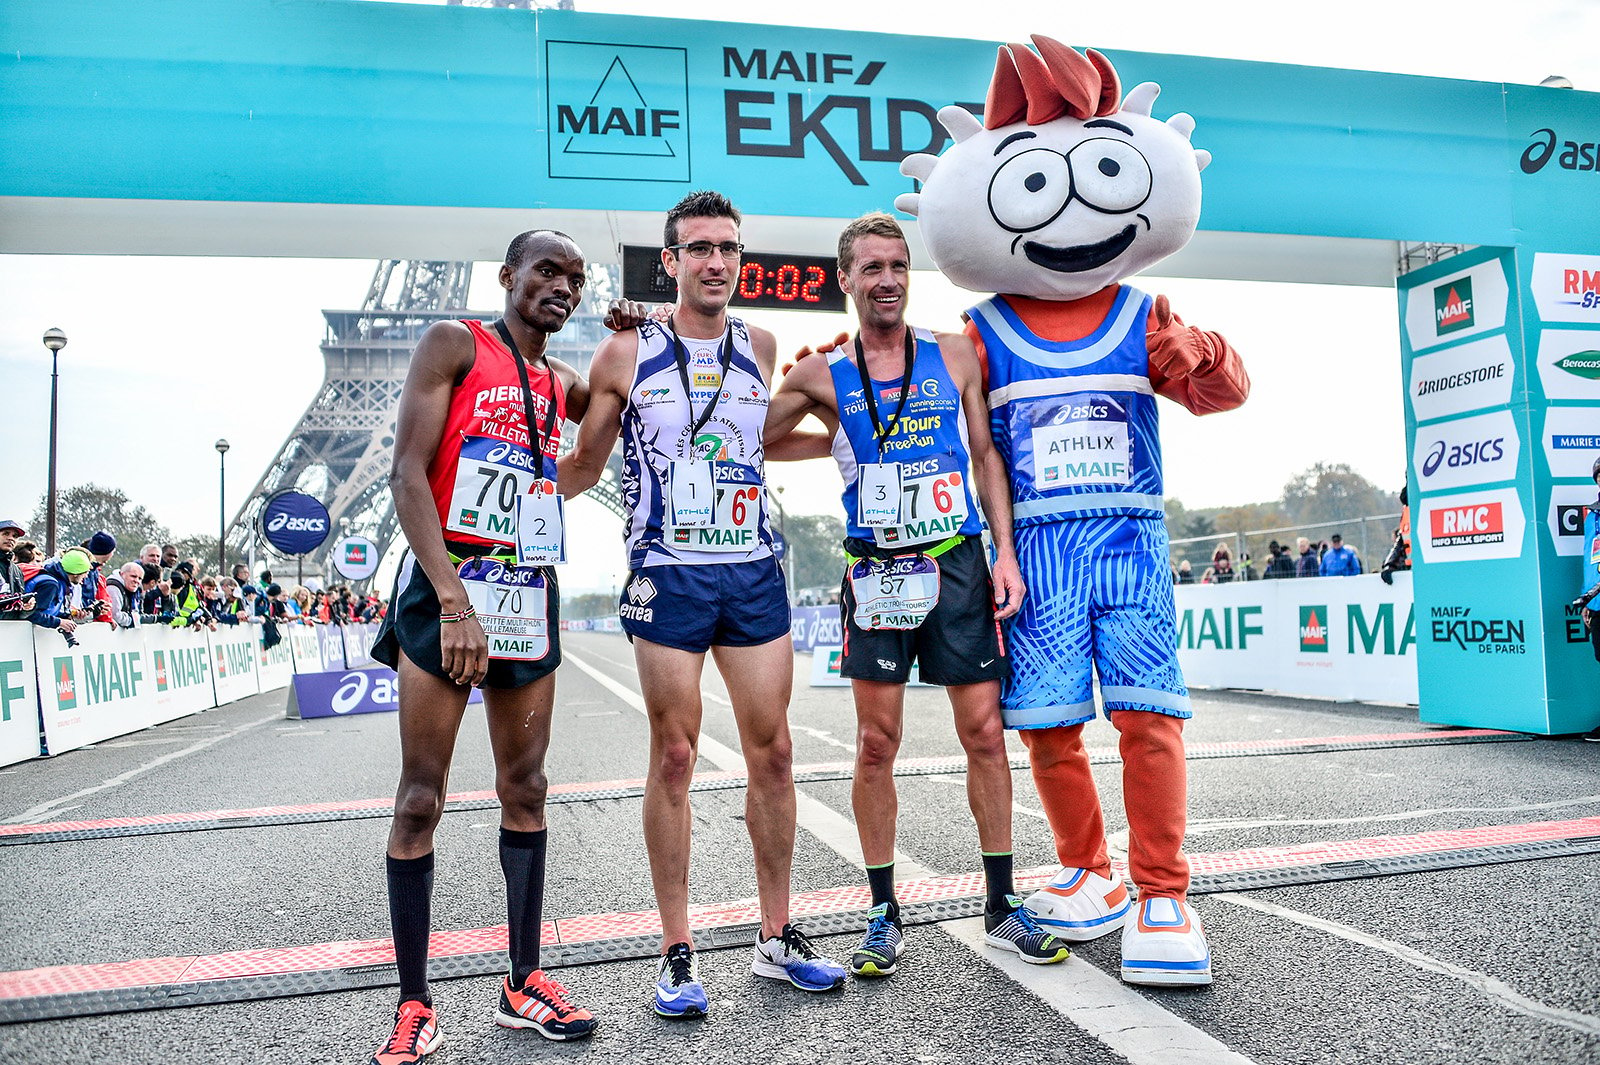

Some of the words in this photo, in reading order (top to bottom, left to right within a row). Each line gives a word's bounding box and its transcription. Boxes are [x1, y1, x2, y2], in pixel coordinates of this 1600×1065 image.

[723, 47, 853, 84] MAIF
[557, 105, 680, 137] MAIF
[1437, 299, 1471, 321] MAIF
[1418, 363, 1505, 396] BRIDGESTONE
[1071, 406, 1108, 419] asics
[720, 417, 745, 458] ATHLÉTISME
[1048, 436, 1115, 455] ATHLIX
[1560, 437, 1593, 447] MAIRIE
[508, 450, 535, 470] asic
[1447, 438, 1504, 467] asics
[1066, 462, 1125, 478] MAIF
[476, 467, 518, 513] 70
[875, 485, 886, 500] 3
[932, 479, 953, 513] 6
[732, 489, 747, 526] 6
[286, 518, 325, 532] asics
[534, 518, 547, 535] 2
[905, 515, 964, 539] MAIF
[1443, 506, 1489, 534] RMC
[699, 530, 752, 545] MAIF
[1432, 537, 1451, 546] INFO
[1451, 536, 1472, 544] TALK
[1473, 534, 1503, 543] SPORT
[880, 576, 905, 595] 57
[497, 588, 522, 614] 70
[620, 603, 653, 623] errea
[885, 615, 925, 626] MAIF
[1431, 607, 1463, 617] MAIF
[1300, 626, 1327, 639] MAIF
[1432, 620, 1525, 651] EKIDEN
[493, 640, 533, 653] MAIF
[1479, 644, 1492, 653] DE
[1495, 645, 1526, 654] PARIS
[170, 647, 208, 689] MAIF
[226, 642, 253, 677] MAIF
[56, 680, 75, 694] MAIF
[83, 652, 142, 706] MAIF
